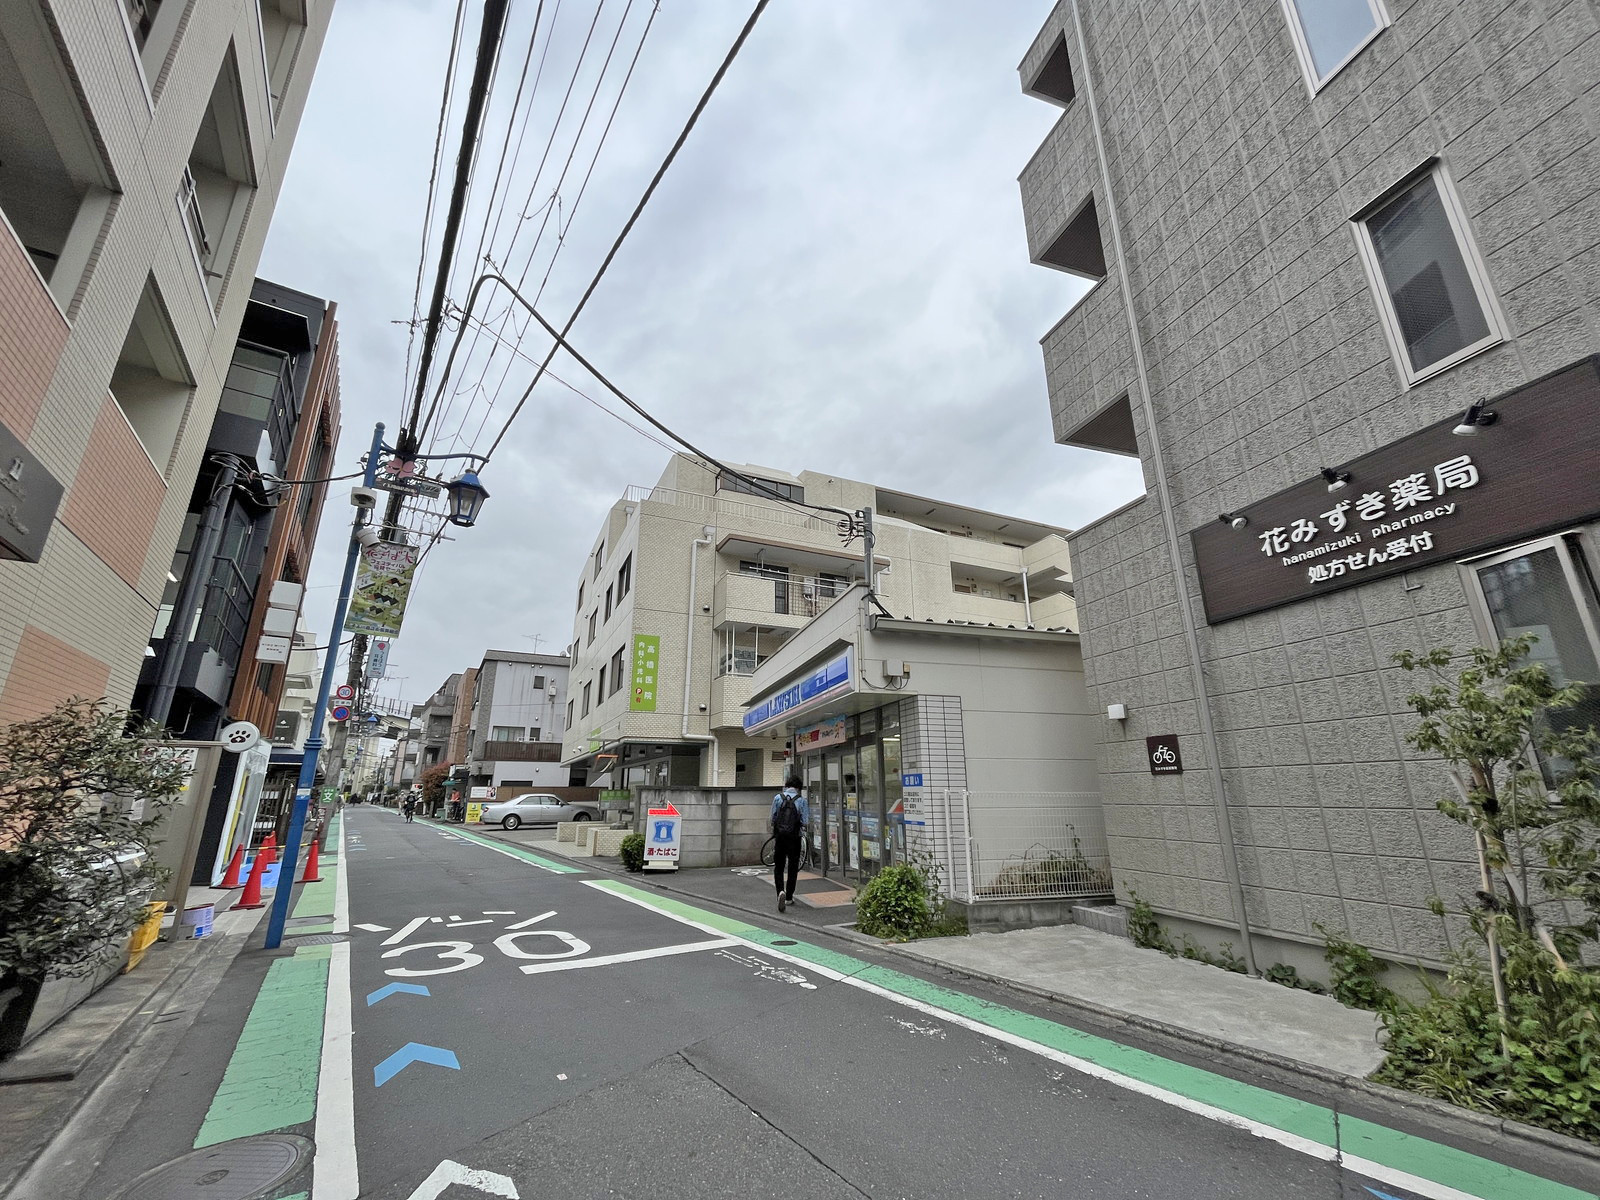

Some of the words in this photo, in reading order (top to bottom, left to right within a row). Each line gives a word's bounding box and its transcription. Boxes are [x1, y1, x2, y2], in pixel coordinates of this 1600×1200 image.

[1258, 454, 1479, 557] 花みずき薬局
[1282, 532, 1362, 567] hanamizuki
[1371, 502, 1456, 538] pharmacy
[1308, 530, 1434, 584] 処方せん受付
[381, 930, 591, 977] 30
